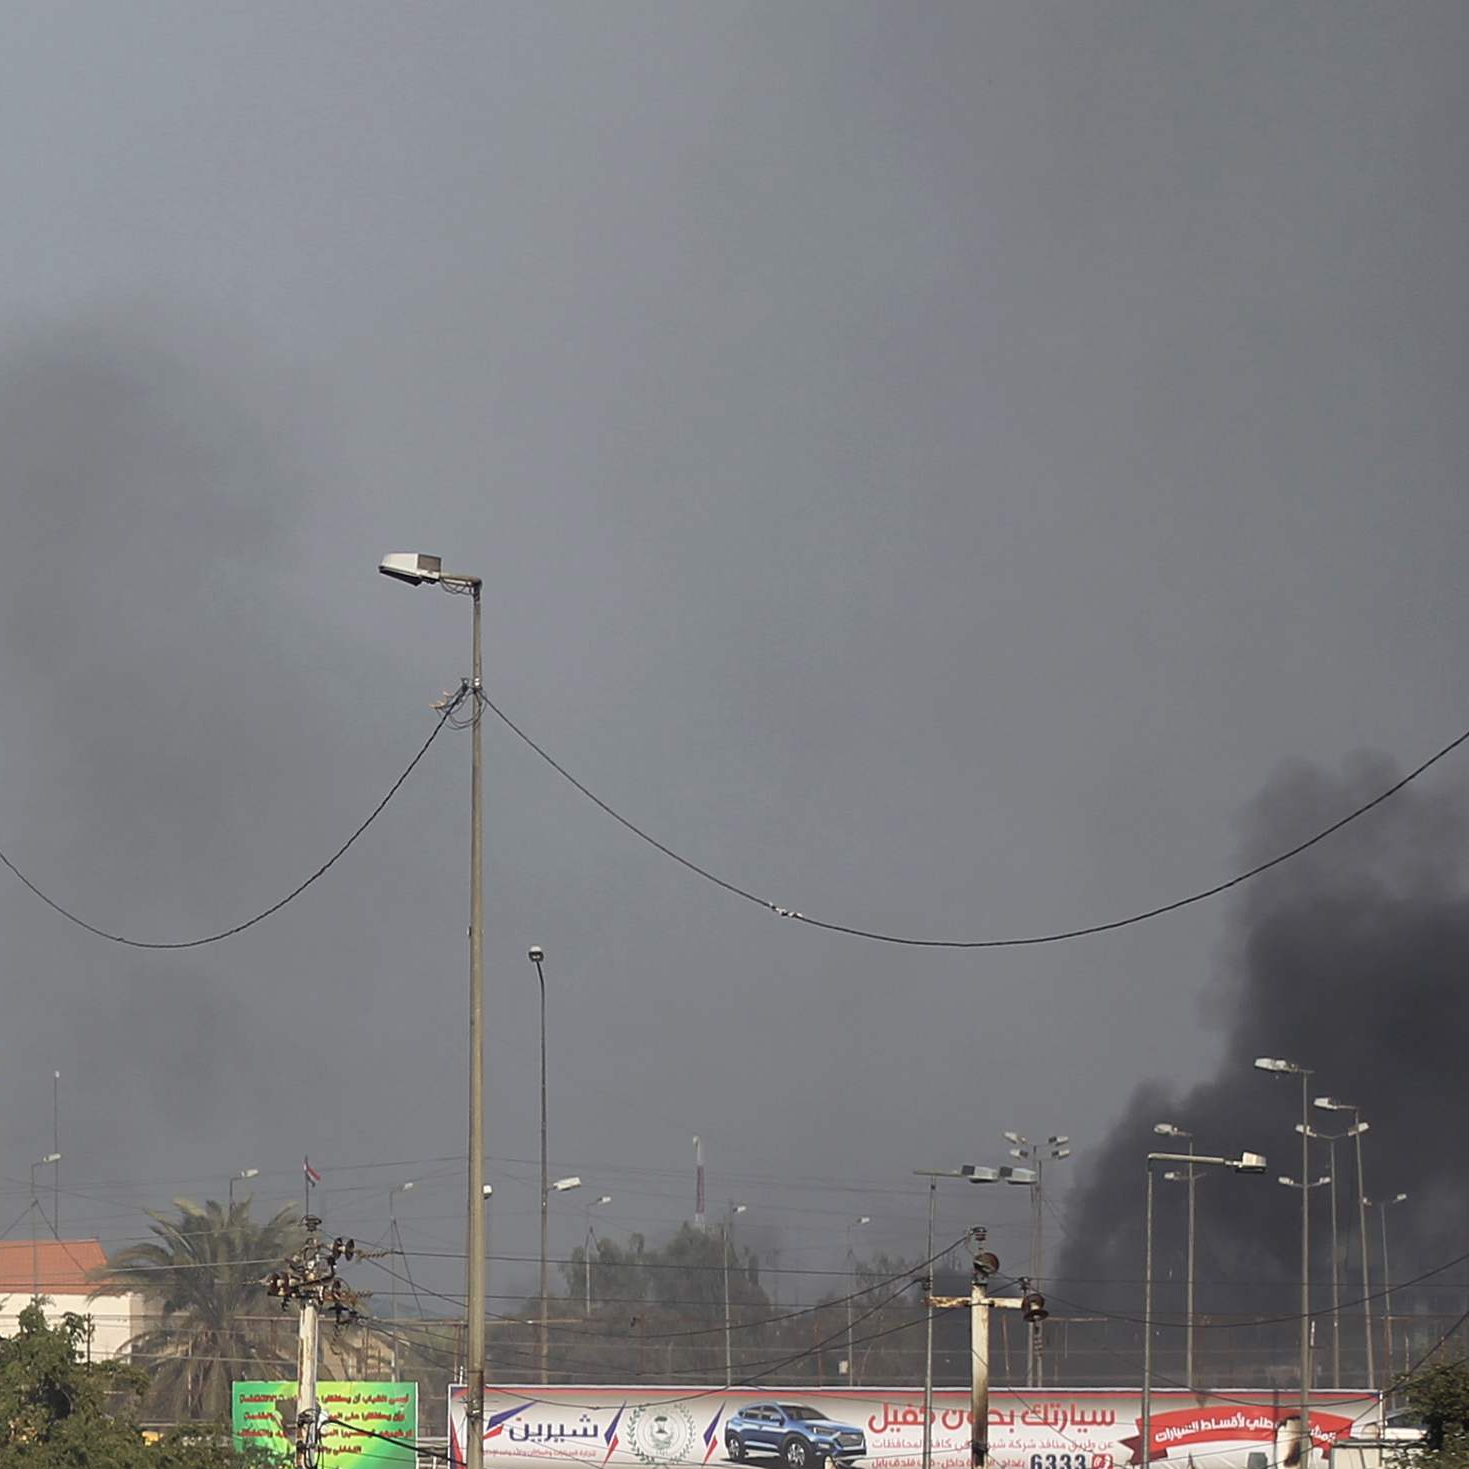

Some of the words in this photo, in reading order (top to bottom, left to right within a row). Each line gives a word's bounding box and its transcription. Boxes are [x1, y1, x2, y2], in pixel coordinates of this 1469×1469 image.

[1021, 1402, 1115, 1433] سيارتك
[1201, 1412, 1245, 1430] لأقساط
[509, 1414, 599, 1442] شيرين
[1155, 1420, 1199, 1443] السيارات
[872, 1438, 922, 1449] لمحافظات
[930, 1438, 952, 1448] كاف
